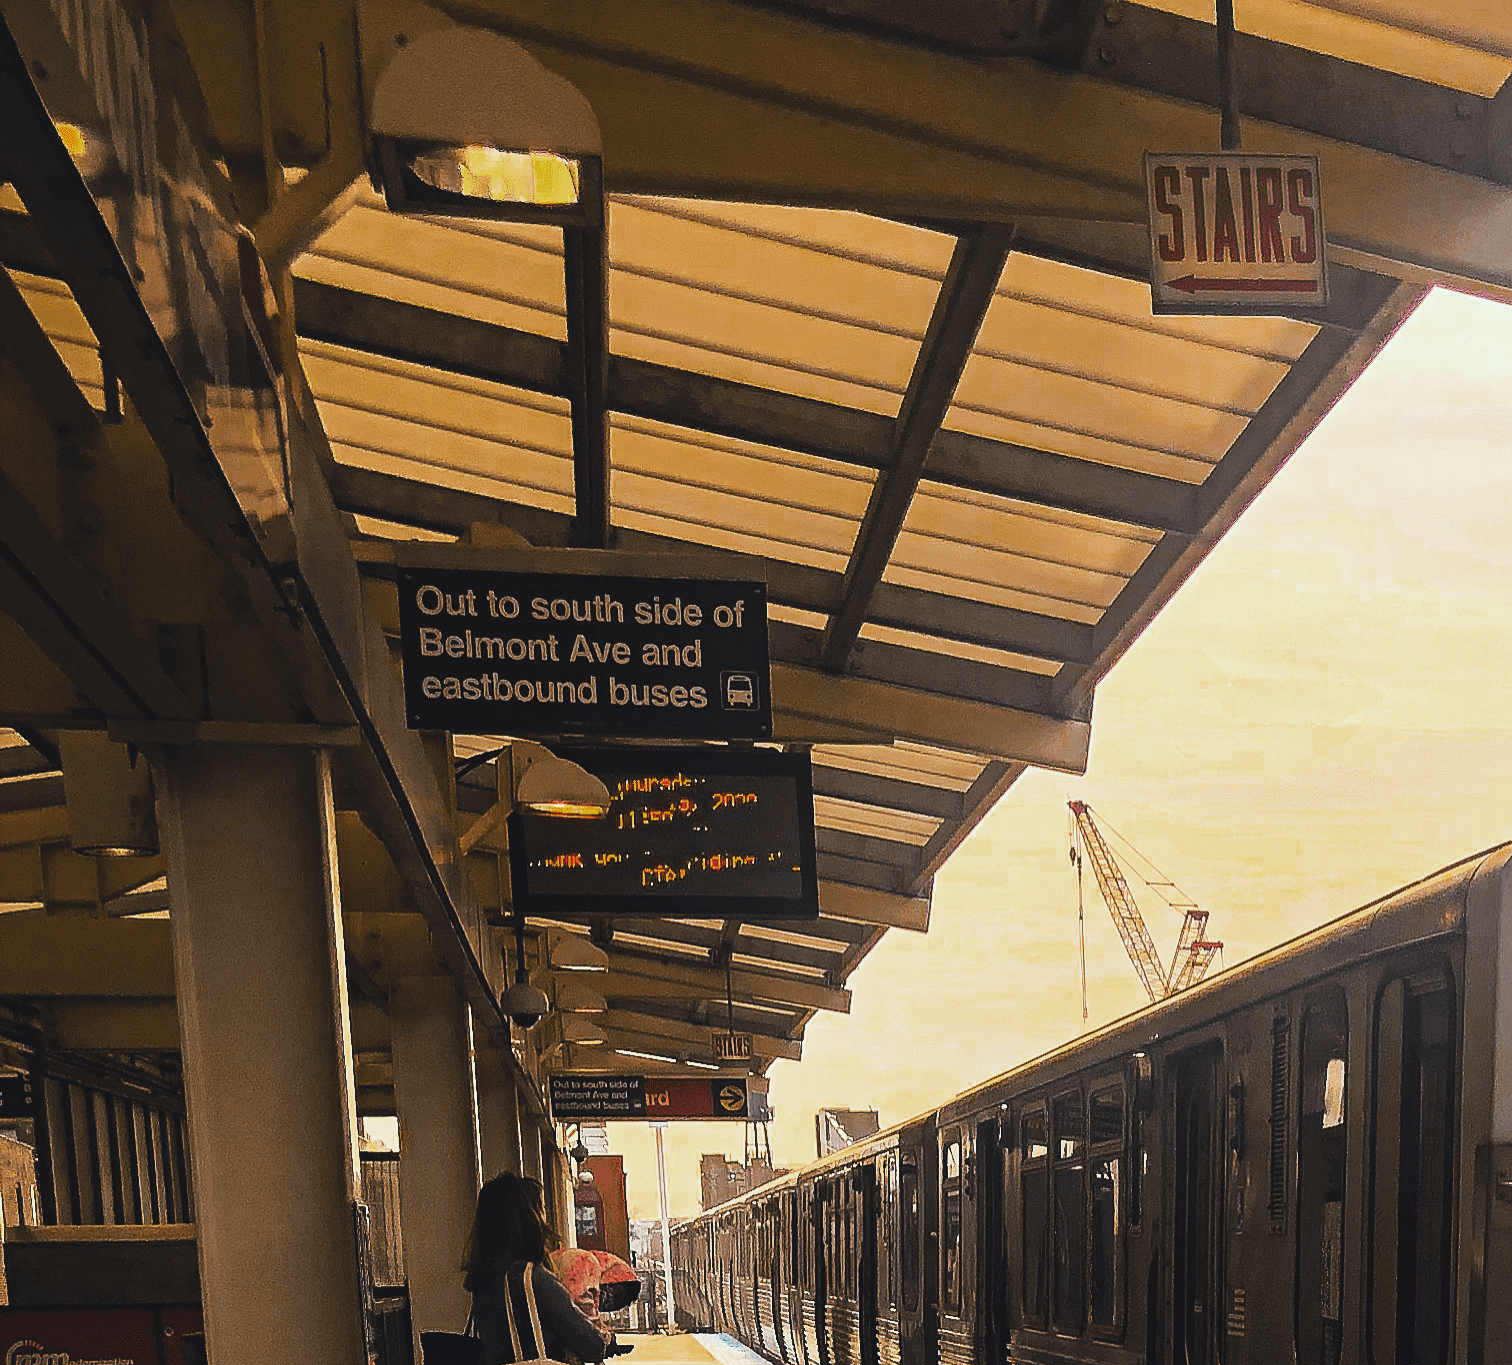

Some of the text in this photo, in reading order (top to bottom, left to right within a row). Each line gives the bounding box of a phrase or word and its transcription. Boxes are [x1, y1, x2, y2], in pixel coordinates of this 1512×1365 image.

[1154, 166, 1317, 263] STAIRS
[415, 585, 745, 628] Out to south side of
[419, 627, 702, 667] Belmont Ave and
[422, 672, 708, 709] eastbound buses
[645, 1090, 670, 1106] rd
